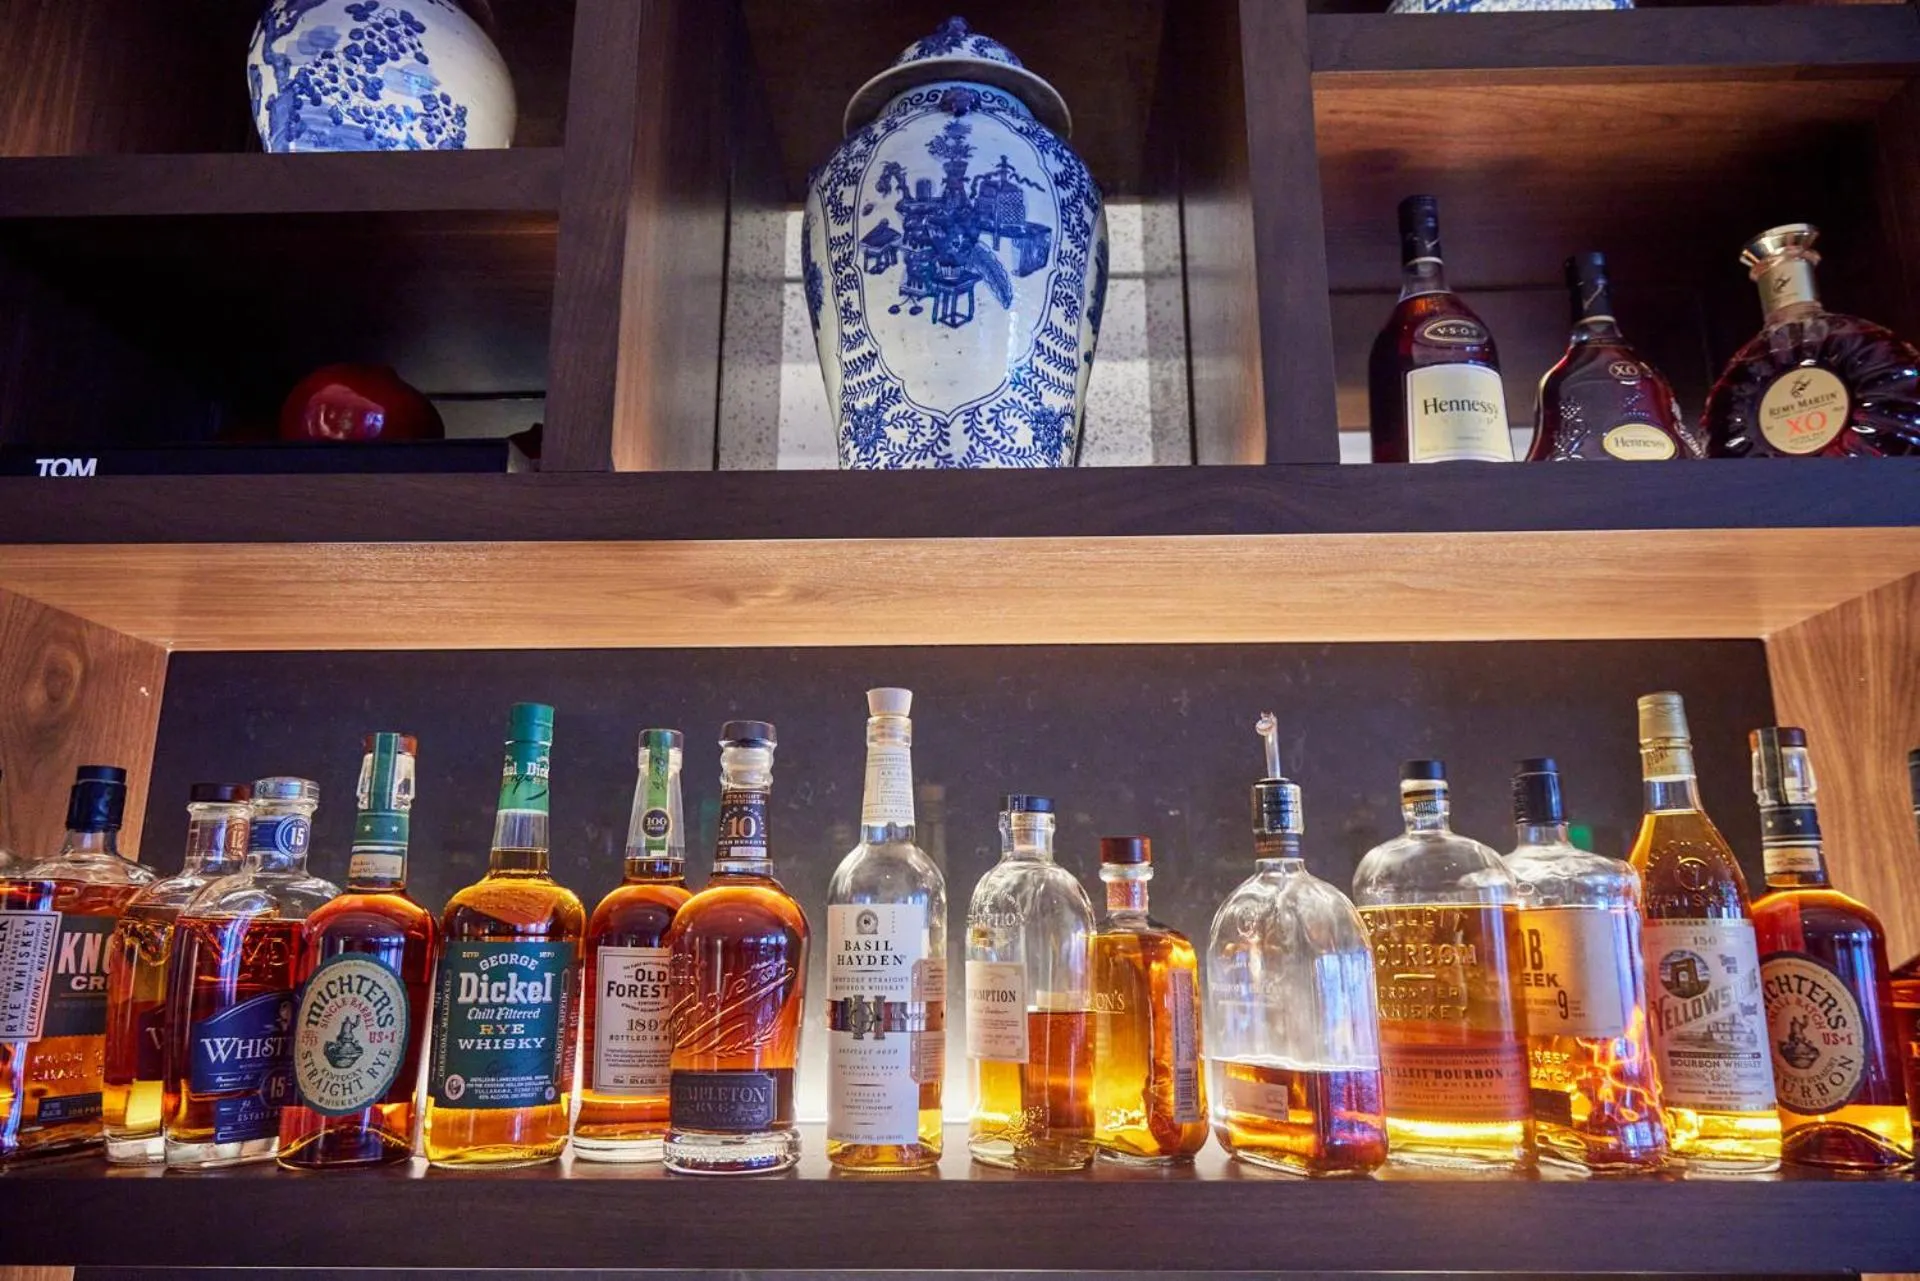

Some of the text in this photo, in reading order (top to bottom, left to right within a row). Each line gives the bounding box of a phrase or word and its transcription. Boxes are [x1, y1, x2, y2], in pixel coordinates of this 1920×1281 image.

[1613, 365, 1638, 376] XO
[1423, 398, 1498, 420] Hennessy
[1797, 391, 1838, 408] MARTIN
[1786, 410, 1828, 438] XO
[35, 458, 98, 477] TOM
[646, 817, 667, 826] 100
[727, 815, 756, 838] 10
[290, 826, 306, 846] 15
[36, 919, 53, 973] KENTUCKY
[844, 940, 893, 952] BASIL
[12, 918, 37, 994] WHISKEY
[479, 952, 539, 971] GEORGE
[837, 954, 903, 966] HAYDEN
[70, 975, 109, 991] CR
[635, 968, 667, 982] OLD
[457, 971, 553, 1004] Dickel
[467, 1005, 541, 1021] Chill Filtered
[1557, 989, 1569, 1020] 9
[5, 1002, 22, 1033] RYE
[479, 1024, 525, 1035] RYE
[458, 1037, 546, 1050] WHISKY
[301, 1047, 392, 1097] STRAIGHT RYE
[1670, 1058, 1720, 1069] BOURBON
[1433, 1067, 1503, 1080] BOURBON
[270, 1076, 287, 1098] 15
